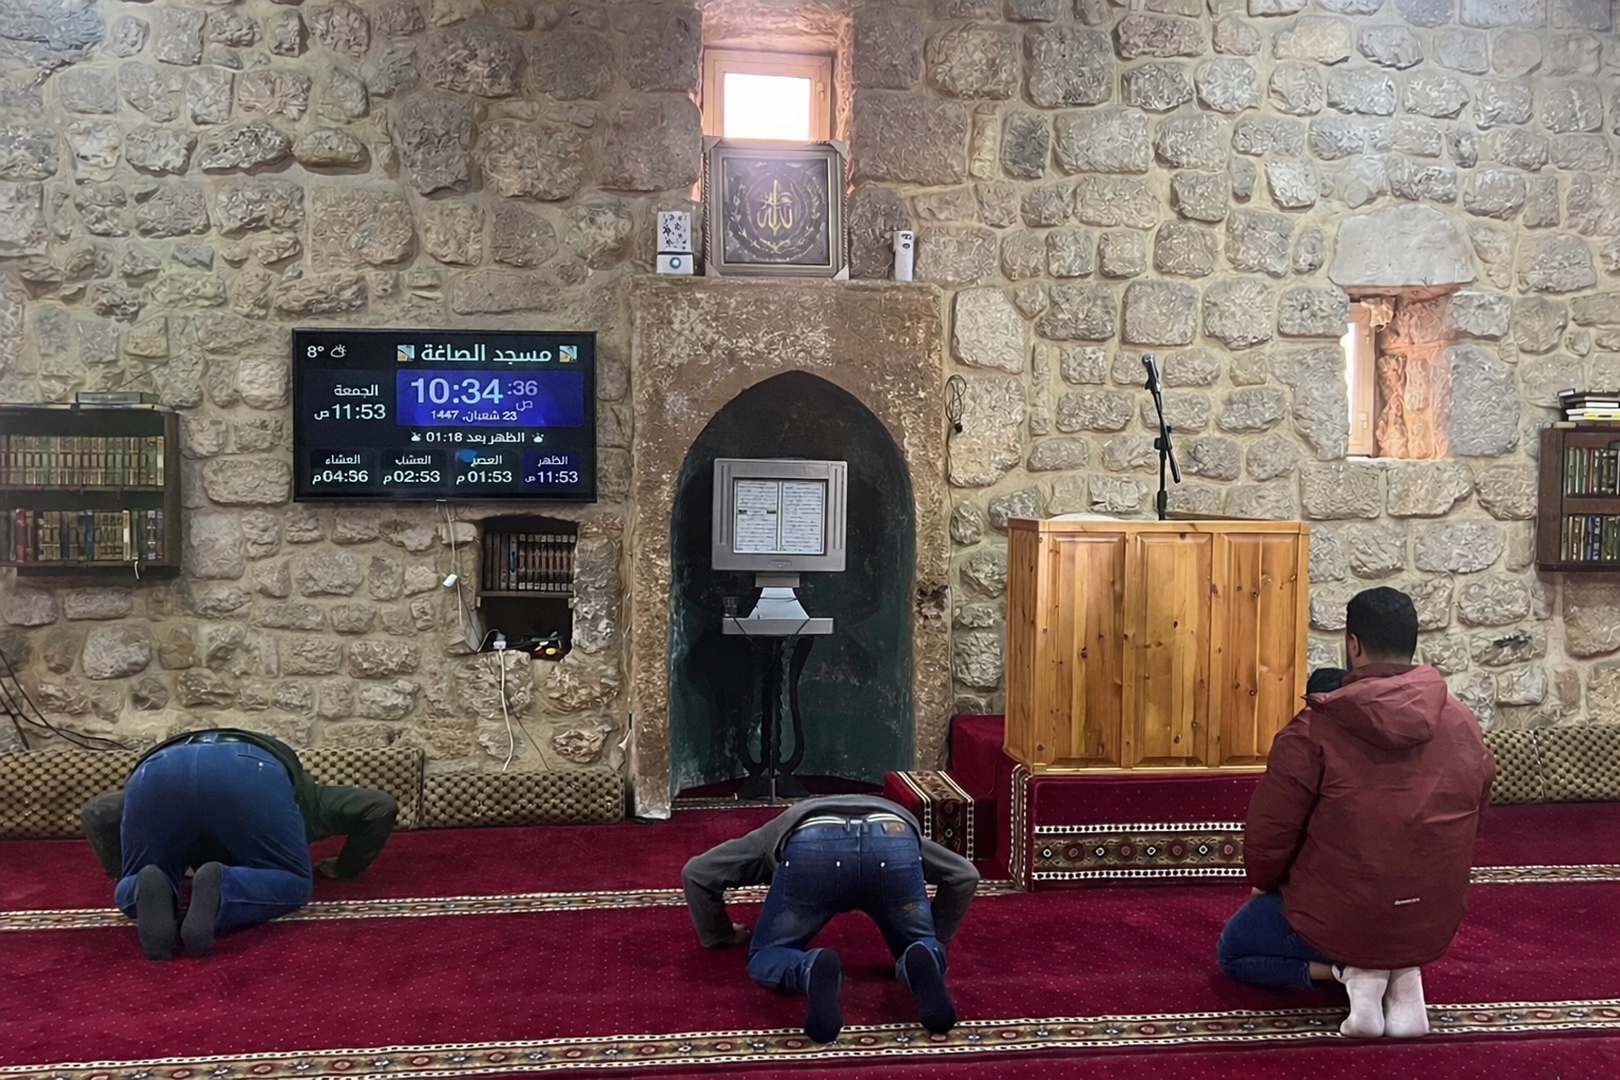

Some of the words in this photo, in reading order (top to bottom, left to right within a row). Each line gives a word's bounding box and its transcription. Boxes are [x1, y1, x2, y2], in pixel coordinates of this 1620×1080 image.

[421, 343, 486, 361] الصاغة
[493, 348, 552, 365] مسجد
[333, 384, 379, 398] الجمعة
[411, 377, 504, 404] 10:34
[331, 403, 386, 420] 11:53
[431, 410, 459, 420] 1447
[502, 411, 517, 420] 23
[466, 434, 486, 444] بعد
[488, 432, 525, 444] الظهر
[325, 454, 361, 465] العشاء
[470, 455, 502, 468] العصر
[537, 456, 568, 468] الظهر
[322, 470, 369, 482] 04:56
[393, 470, 440, 482] 02:53
[467, 471, 513, 483] 01:53
[537, 471, 579, 483] 11:53
